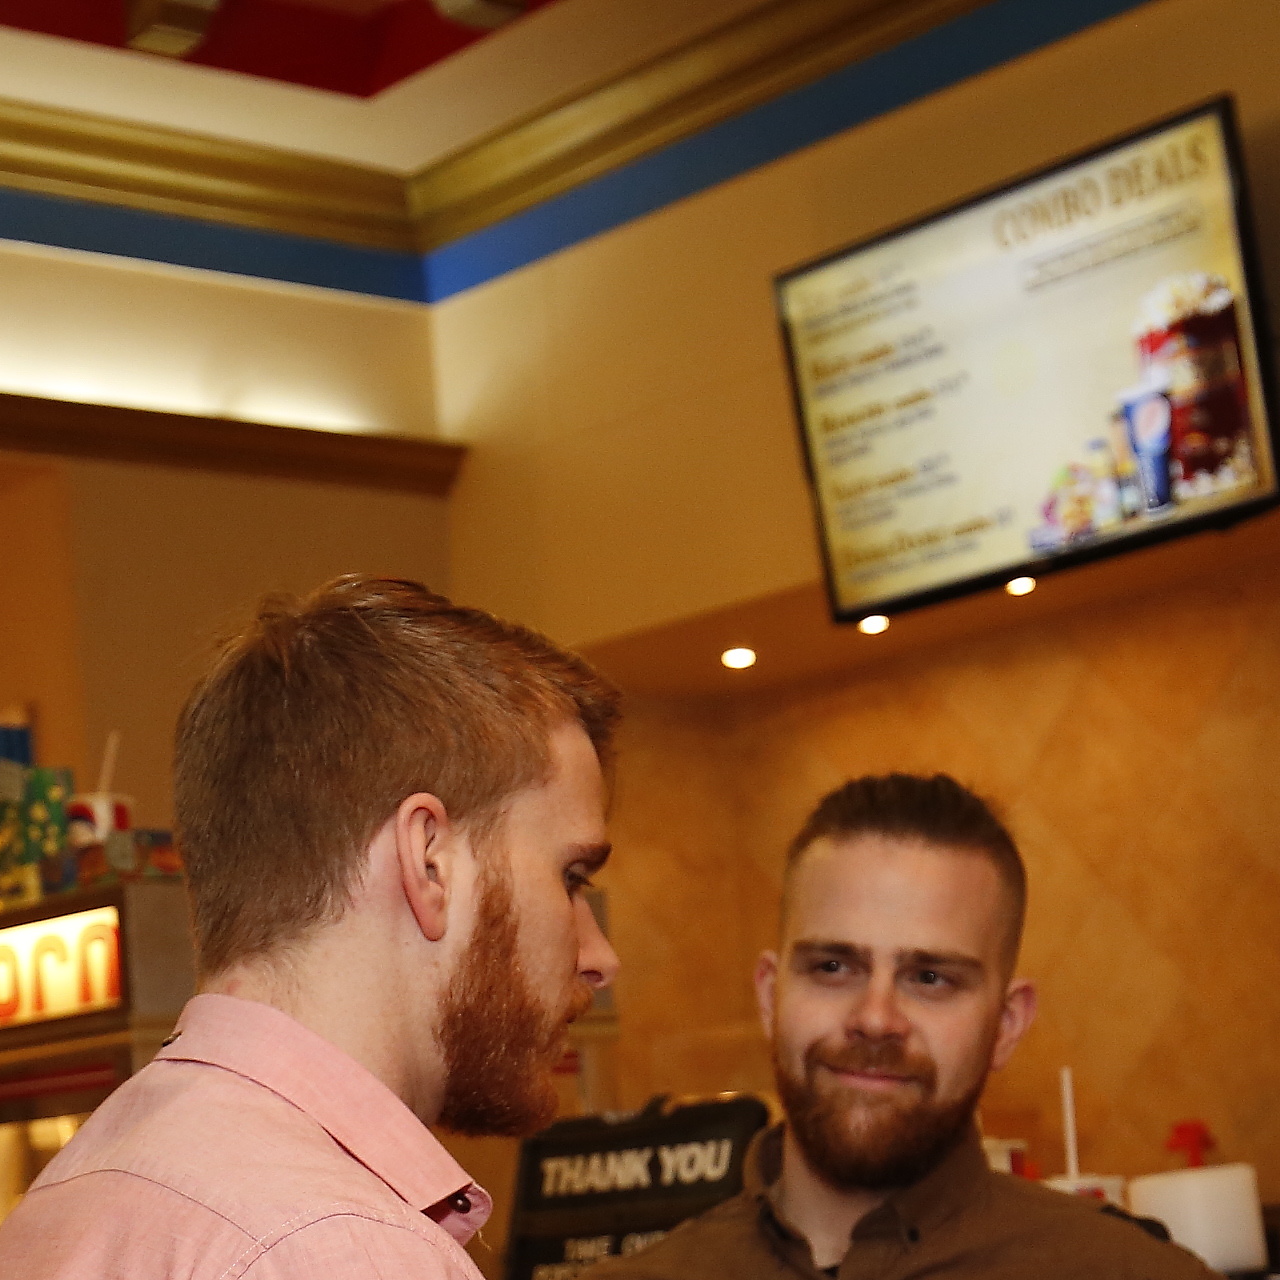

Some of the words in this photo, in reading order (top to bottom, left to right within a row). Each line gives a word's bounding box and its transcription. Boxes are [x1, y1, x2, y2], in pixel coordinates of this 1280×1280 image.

[992, 176, 1103, 252] COMBO
[1105, 132, 1211, 207] DEALS
[540, 1146, 653, 1198] THANK
[658, 1138, 734, 1187] YOU
